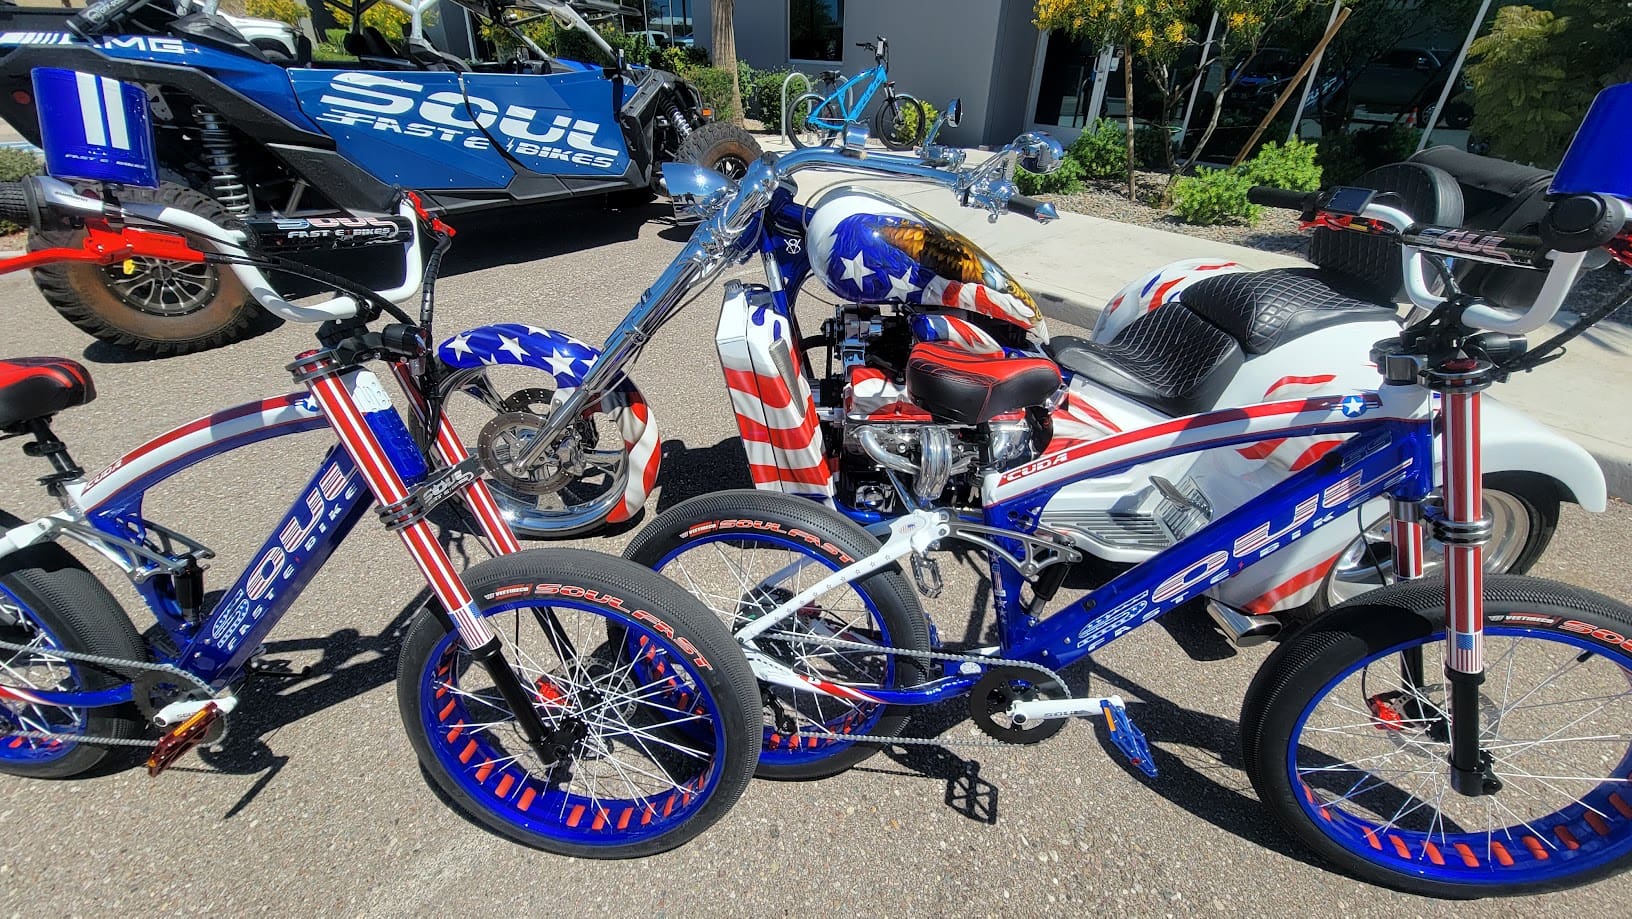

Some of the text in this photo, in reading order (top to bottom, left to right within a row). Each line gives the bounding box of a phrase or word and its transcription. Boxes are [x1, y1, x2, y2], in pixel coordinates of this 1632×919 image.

[316, 109, 464, 140] FAST
[514, 141, 615, 168] BIKES
[319, 72, 619, 156] SOUL
[287, 229, 331, 239] FAST
[227, 588, 274, 650] FAST
[305, 483, 357, 551] BIKE
[719, 519, 787, 534] SOUL
[788, 528, 856, 563] FAST
[1077, 457, 1414, 648] SOUL
[1088, 591, 1190, 651] FAST
[1259, 471, 1407, 558] BIKES
[534, 583, 630, 614] SOUL
[631, 609, 713, 671] FAST
